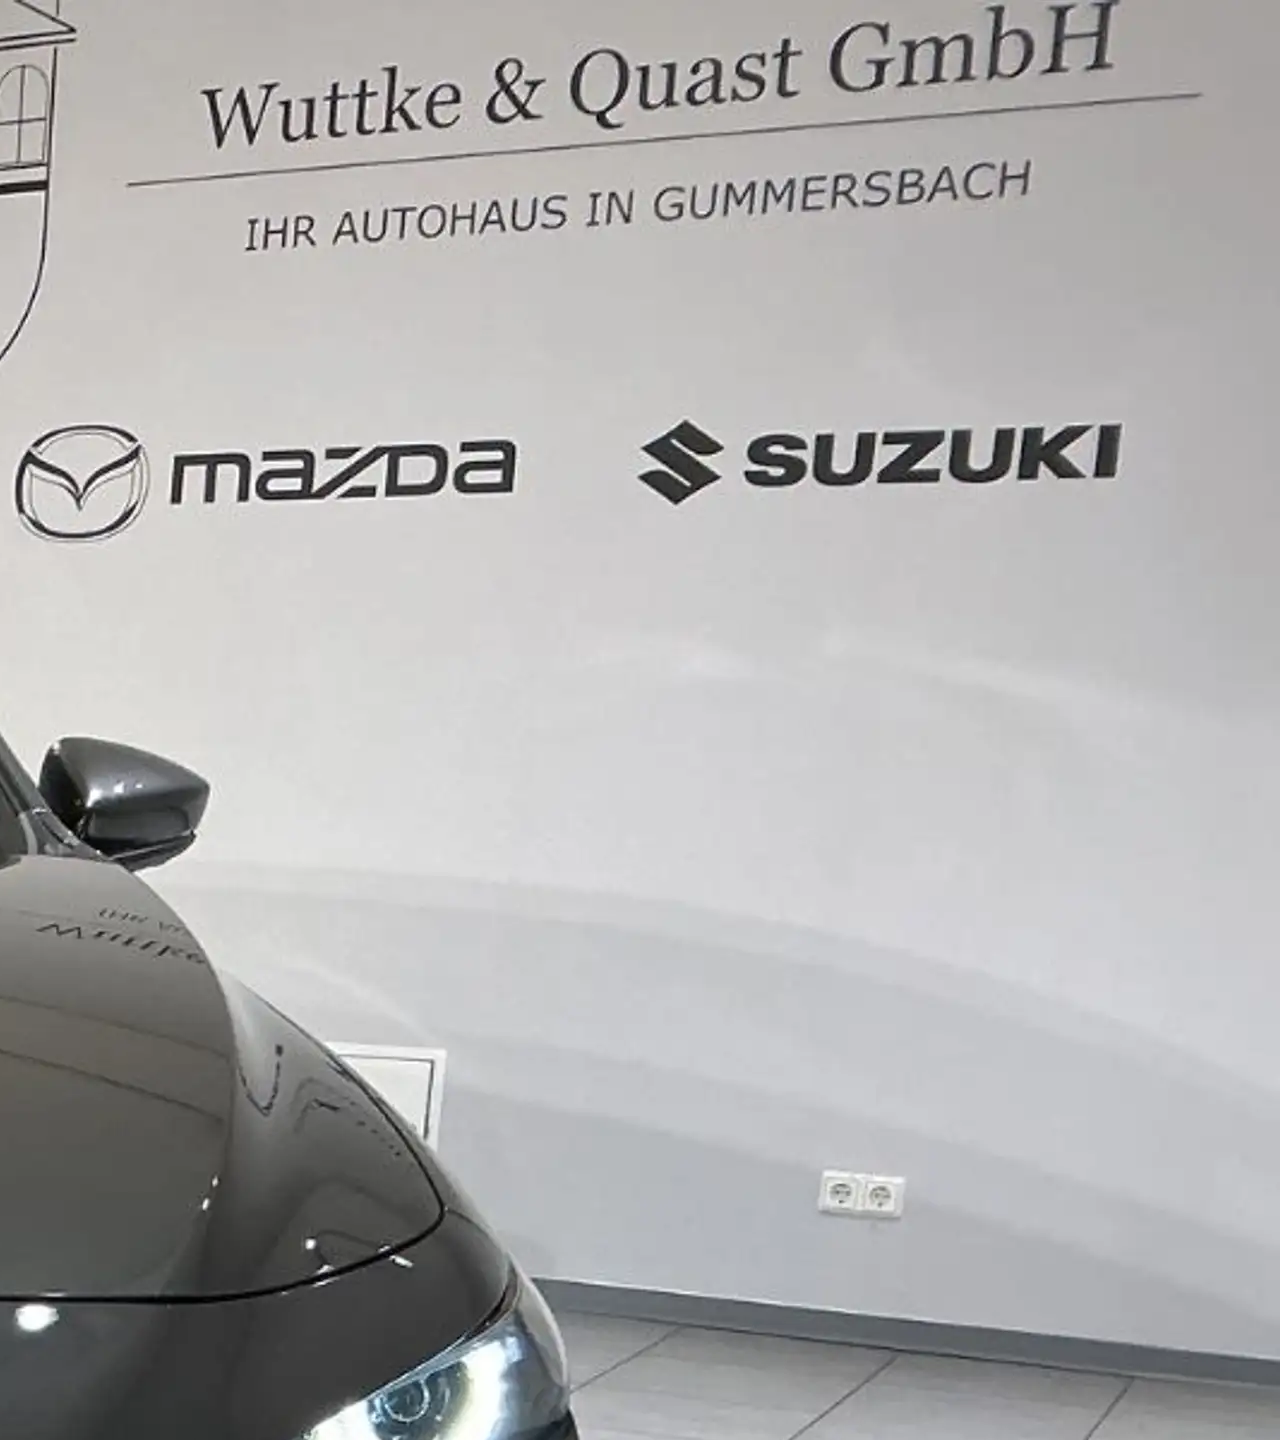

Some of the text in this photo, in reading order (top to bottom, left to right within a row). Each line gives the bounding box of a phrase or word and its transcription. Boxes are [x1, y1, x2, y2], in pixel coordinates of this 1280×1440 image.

[200, 0, 1117, 149] Wuttke & Quast GmbH
[245, 159, 1032, 252] IHR AUTOHAUS IN GUMMERSBACH
[743, 423, 1122, 488] SUZUKI
